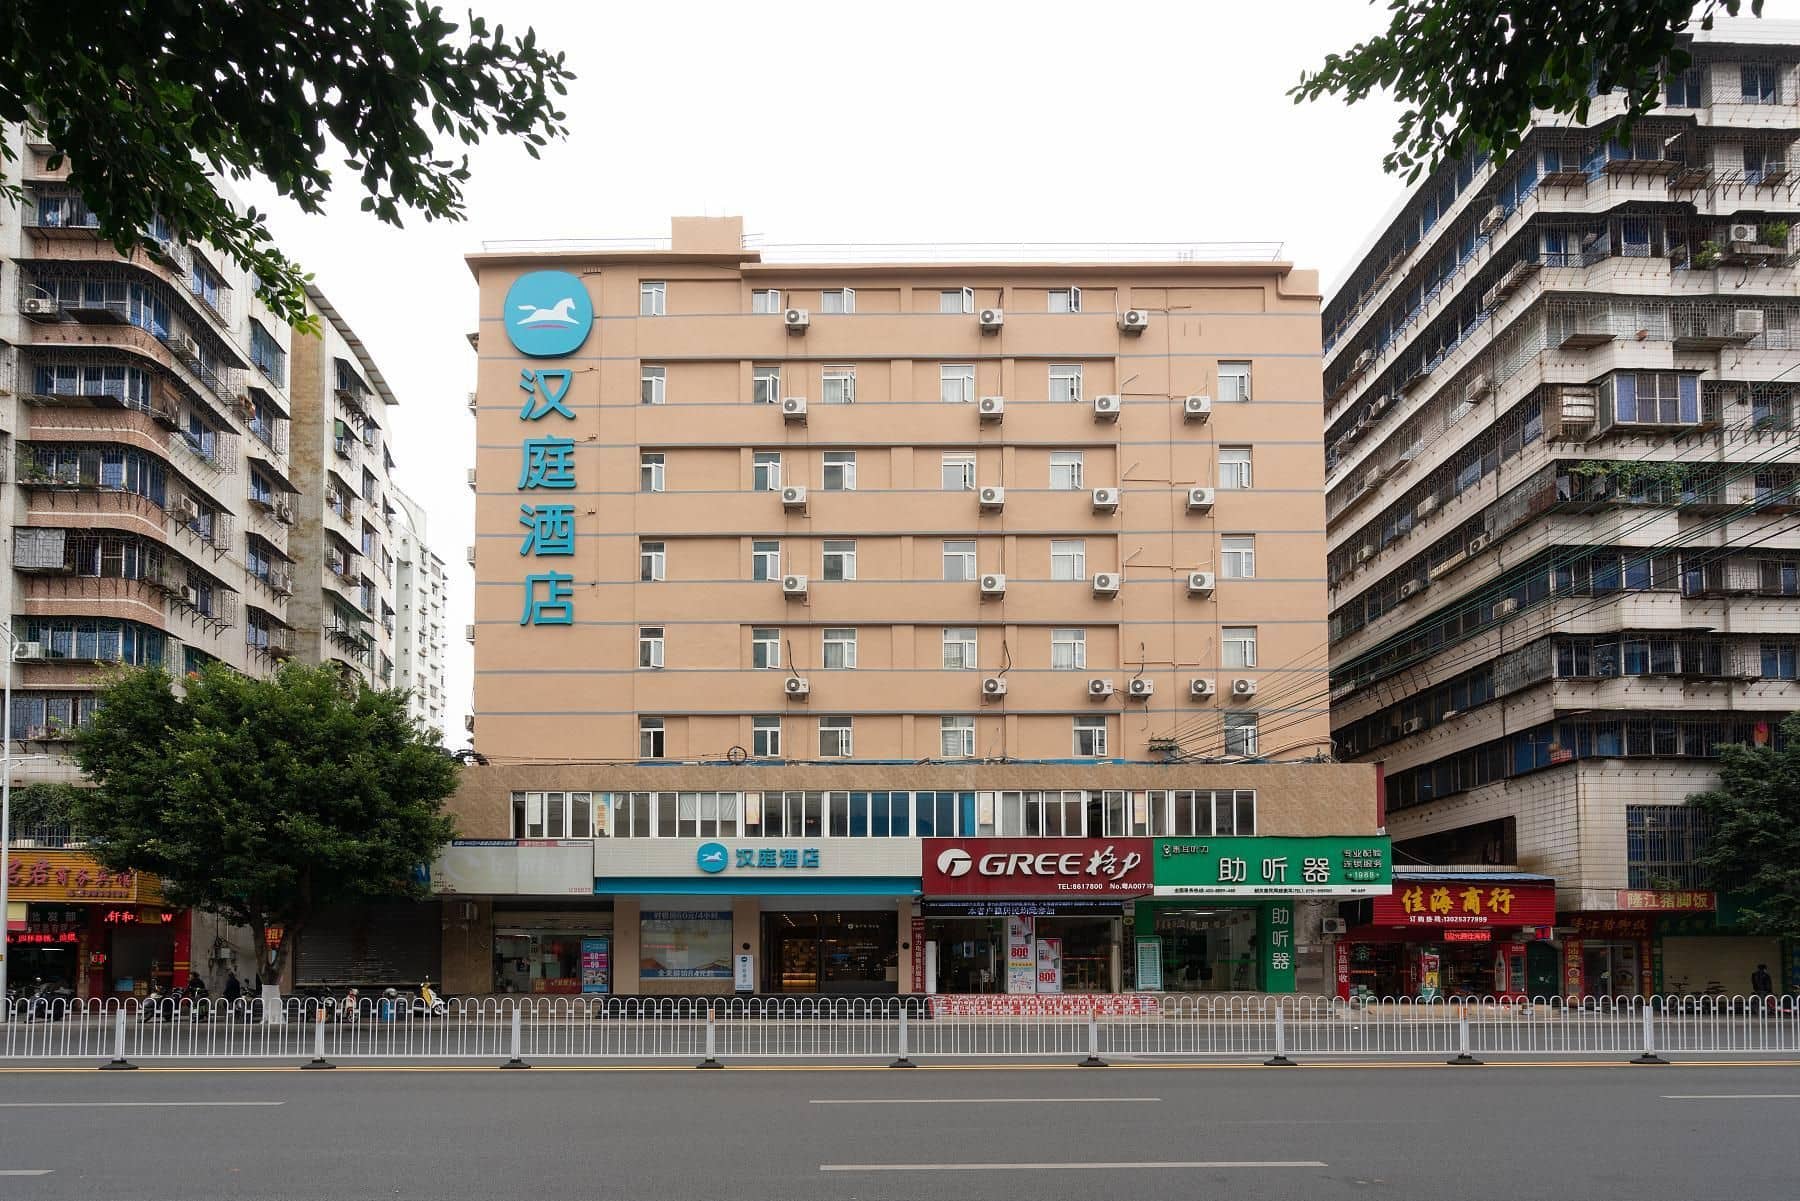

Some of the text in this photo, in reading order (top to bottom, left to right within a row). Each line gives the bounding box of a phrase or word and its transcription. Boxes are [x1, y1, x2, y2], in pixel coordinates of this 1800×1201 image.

[518, 368, 577, 627] 汉庭酒店
[735, 847, 820, 868] 汉庭酒店
[979, 845, 1141, 881] GREE 格力
[1217, 856, 1332, 883] 助听器
[1402, 885, 1516, 915] 佳海商行
[1626, 893, 1709, 909] 隆江猪脚饭
[1271, 906, 1290, 970] 助听器
[1011, 947, 1029, 958] 800
[1039, 971, 1056, 982] 800
